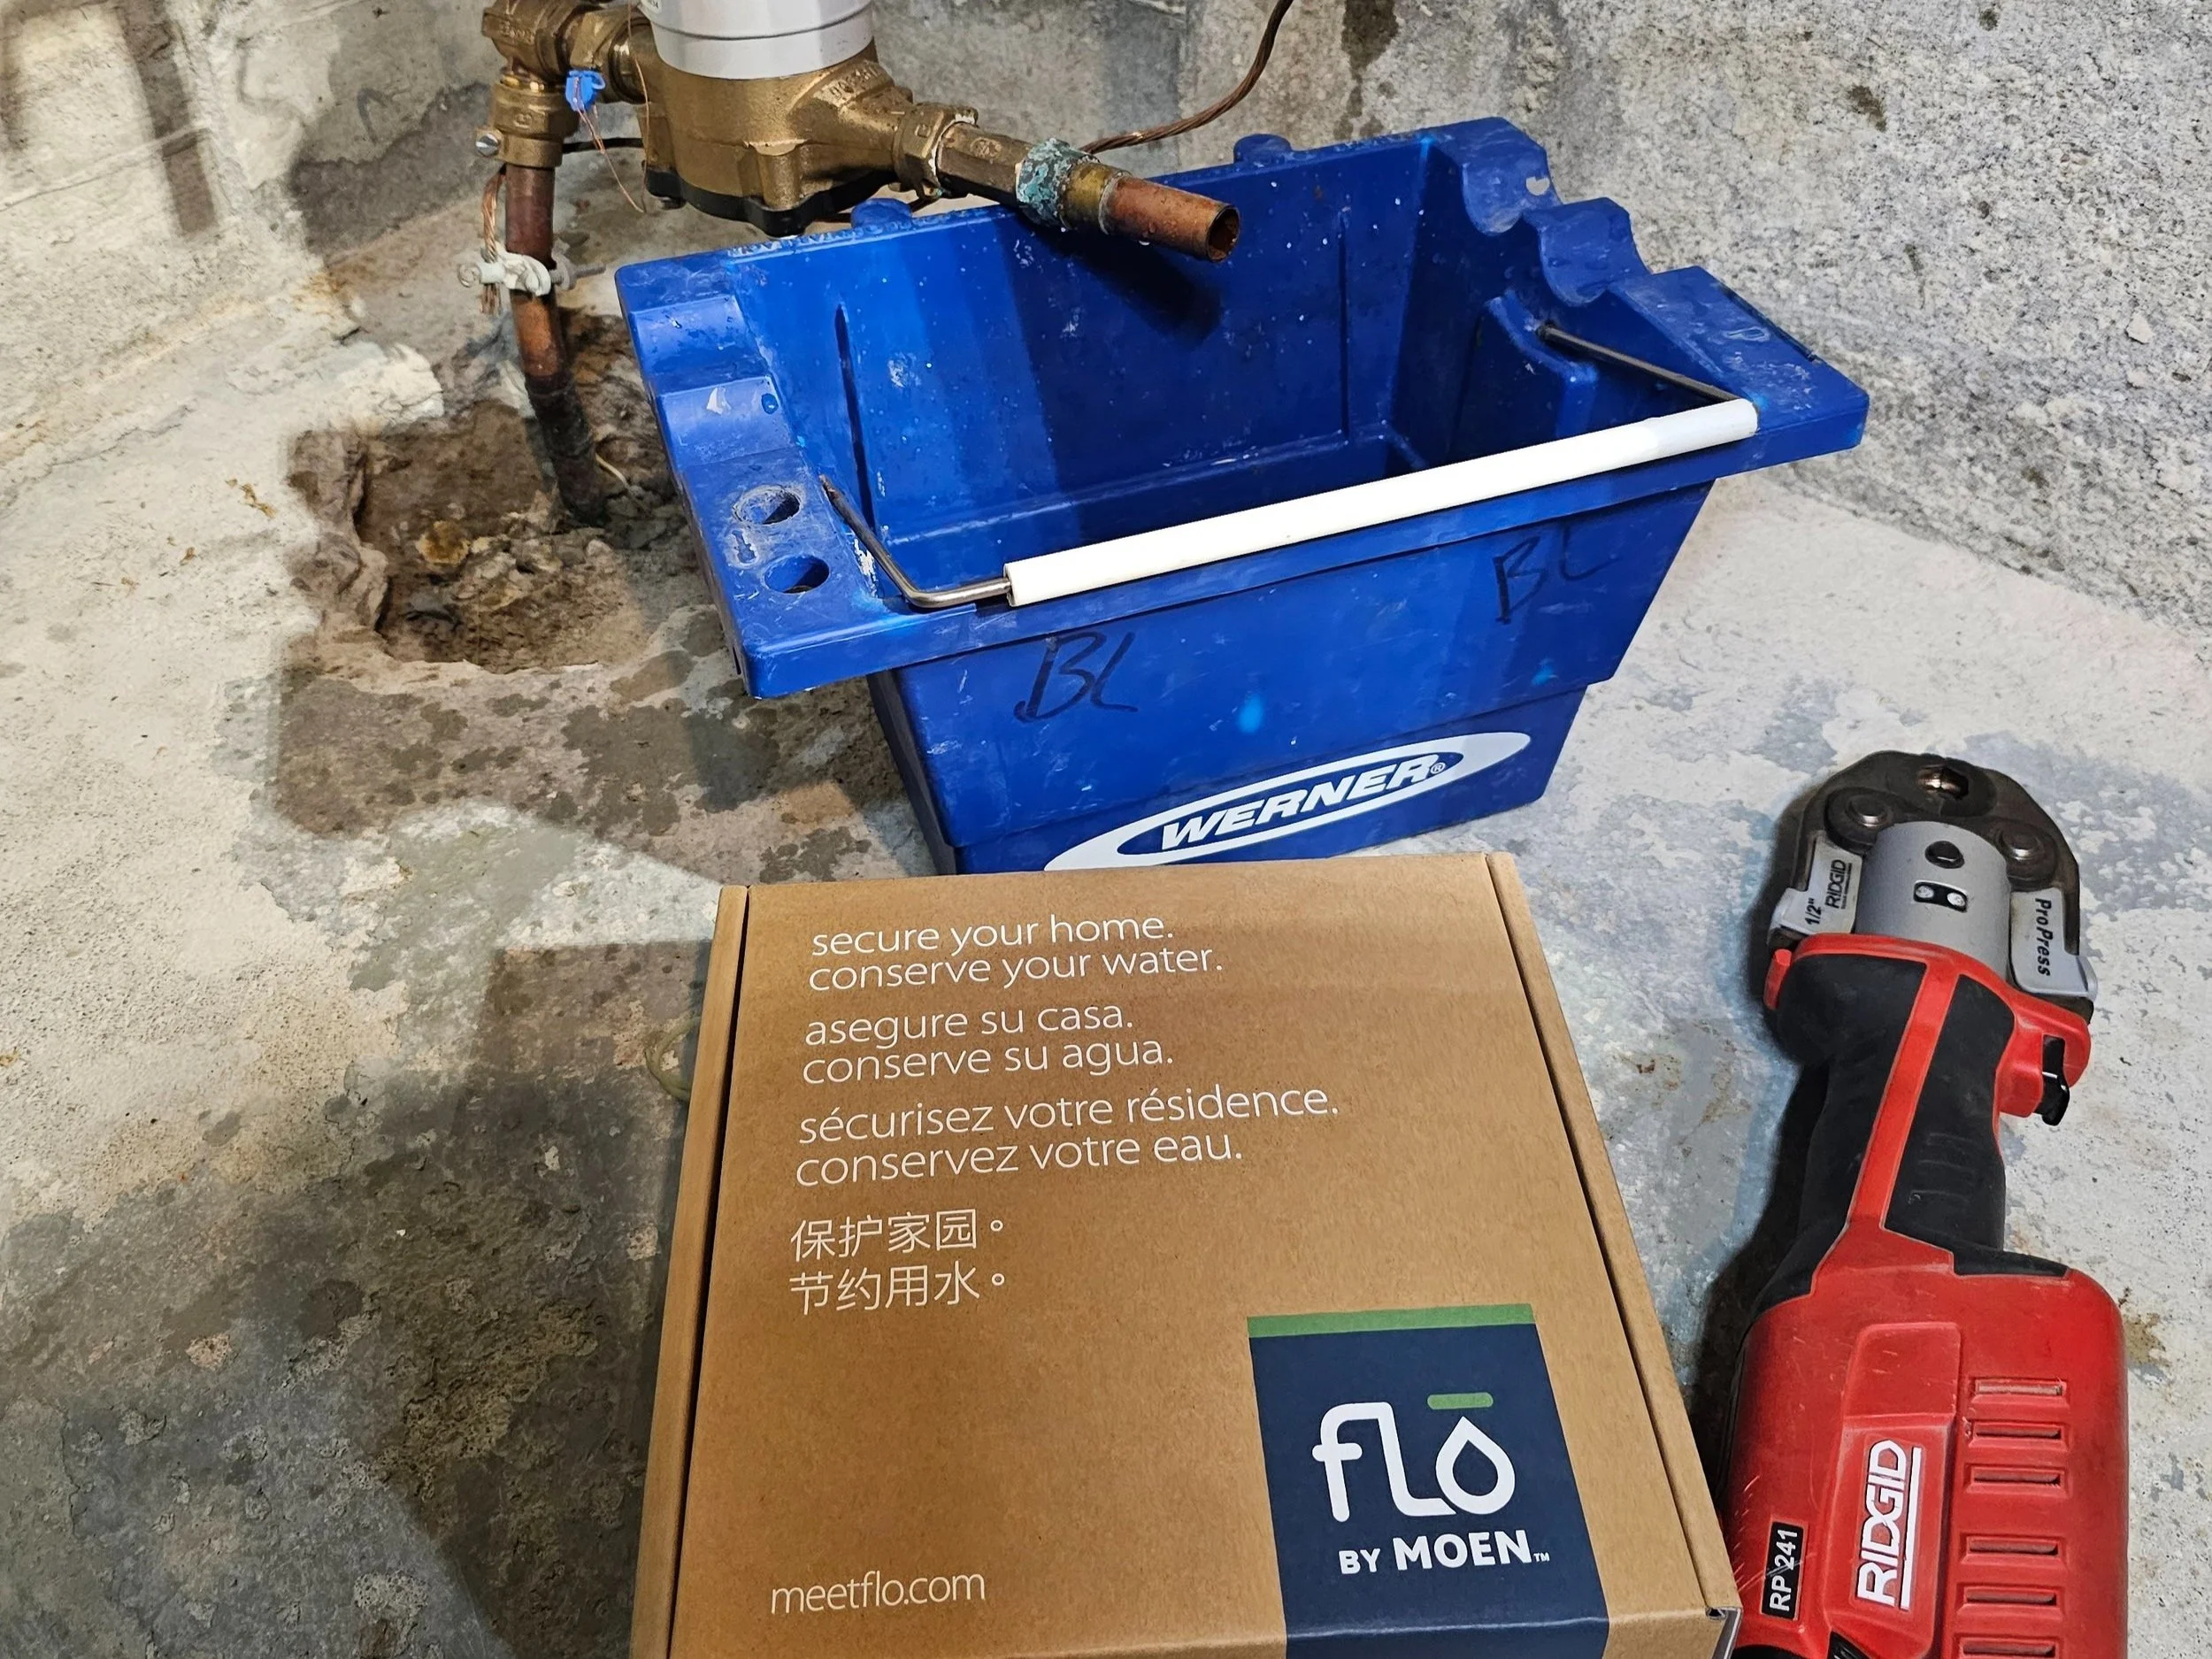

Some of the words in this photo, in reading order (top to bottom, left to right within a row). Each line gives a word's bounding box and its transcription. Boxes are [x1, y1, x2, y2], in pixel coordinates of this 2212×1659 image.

[1824, 859, 1847, 909] RIDGID
[811, 926, 940, 956] secure
[949, 918, 1040, 954] your
[1050, 913, 1174, 944] home.
[809, 960, 991, 991] conserve
[1002, 952, 1091, 988] your
[1102, 946, 1224, 975] water.
[804, 1009, 969, 1049] asegure
[980, 1009, 1025, 1033] su
[1037, 1003, 1134, 1032] casa.
[803, 1051, 991, 1085] conserve
[1004, 1044, 1048, 1071] su
[1062, 1039, 1174, 1076] agua.
[799, 1102, 994, 1144] sécurisez
[1003, 1094, 1113, 1130] votre
[1126, 1084, 1340, 1124] résidence.
[796, 1143, 1019, 1187] conservez
[1029, 1135, 1141, 1170] votre
[1153, 1131, 1243, 1164] eau.
[790, 1209, 1004, 1262] 保护家园。
[789, 1260, 1005, 1315] 节约用水。
[1856, 1439, 1907, 1607] RIDGID
[1339, 1548, 1381, 1575] BY
[771, 1570, 986, 1616] meetflo.com
